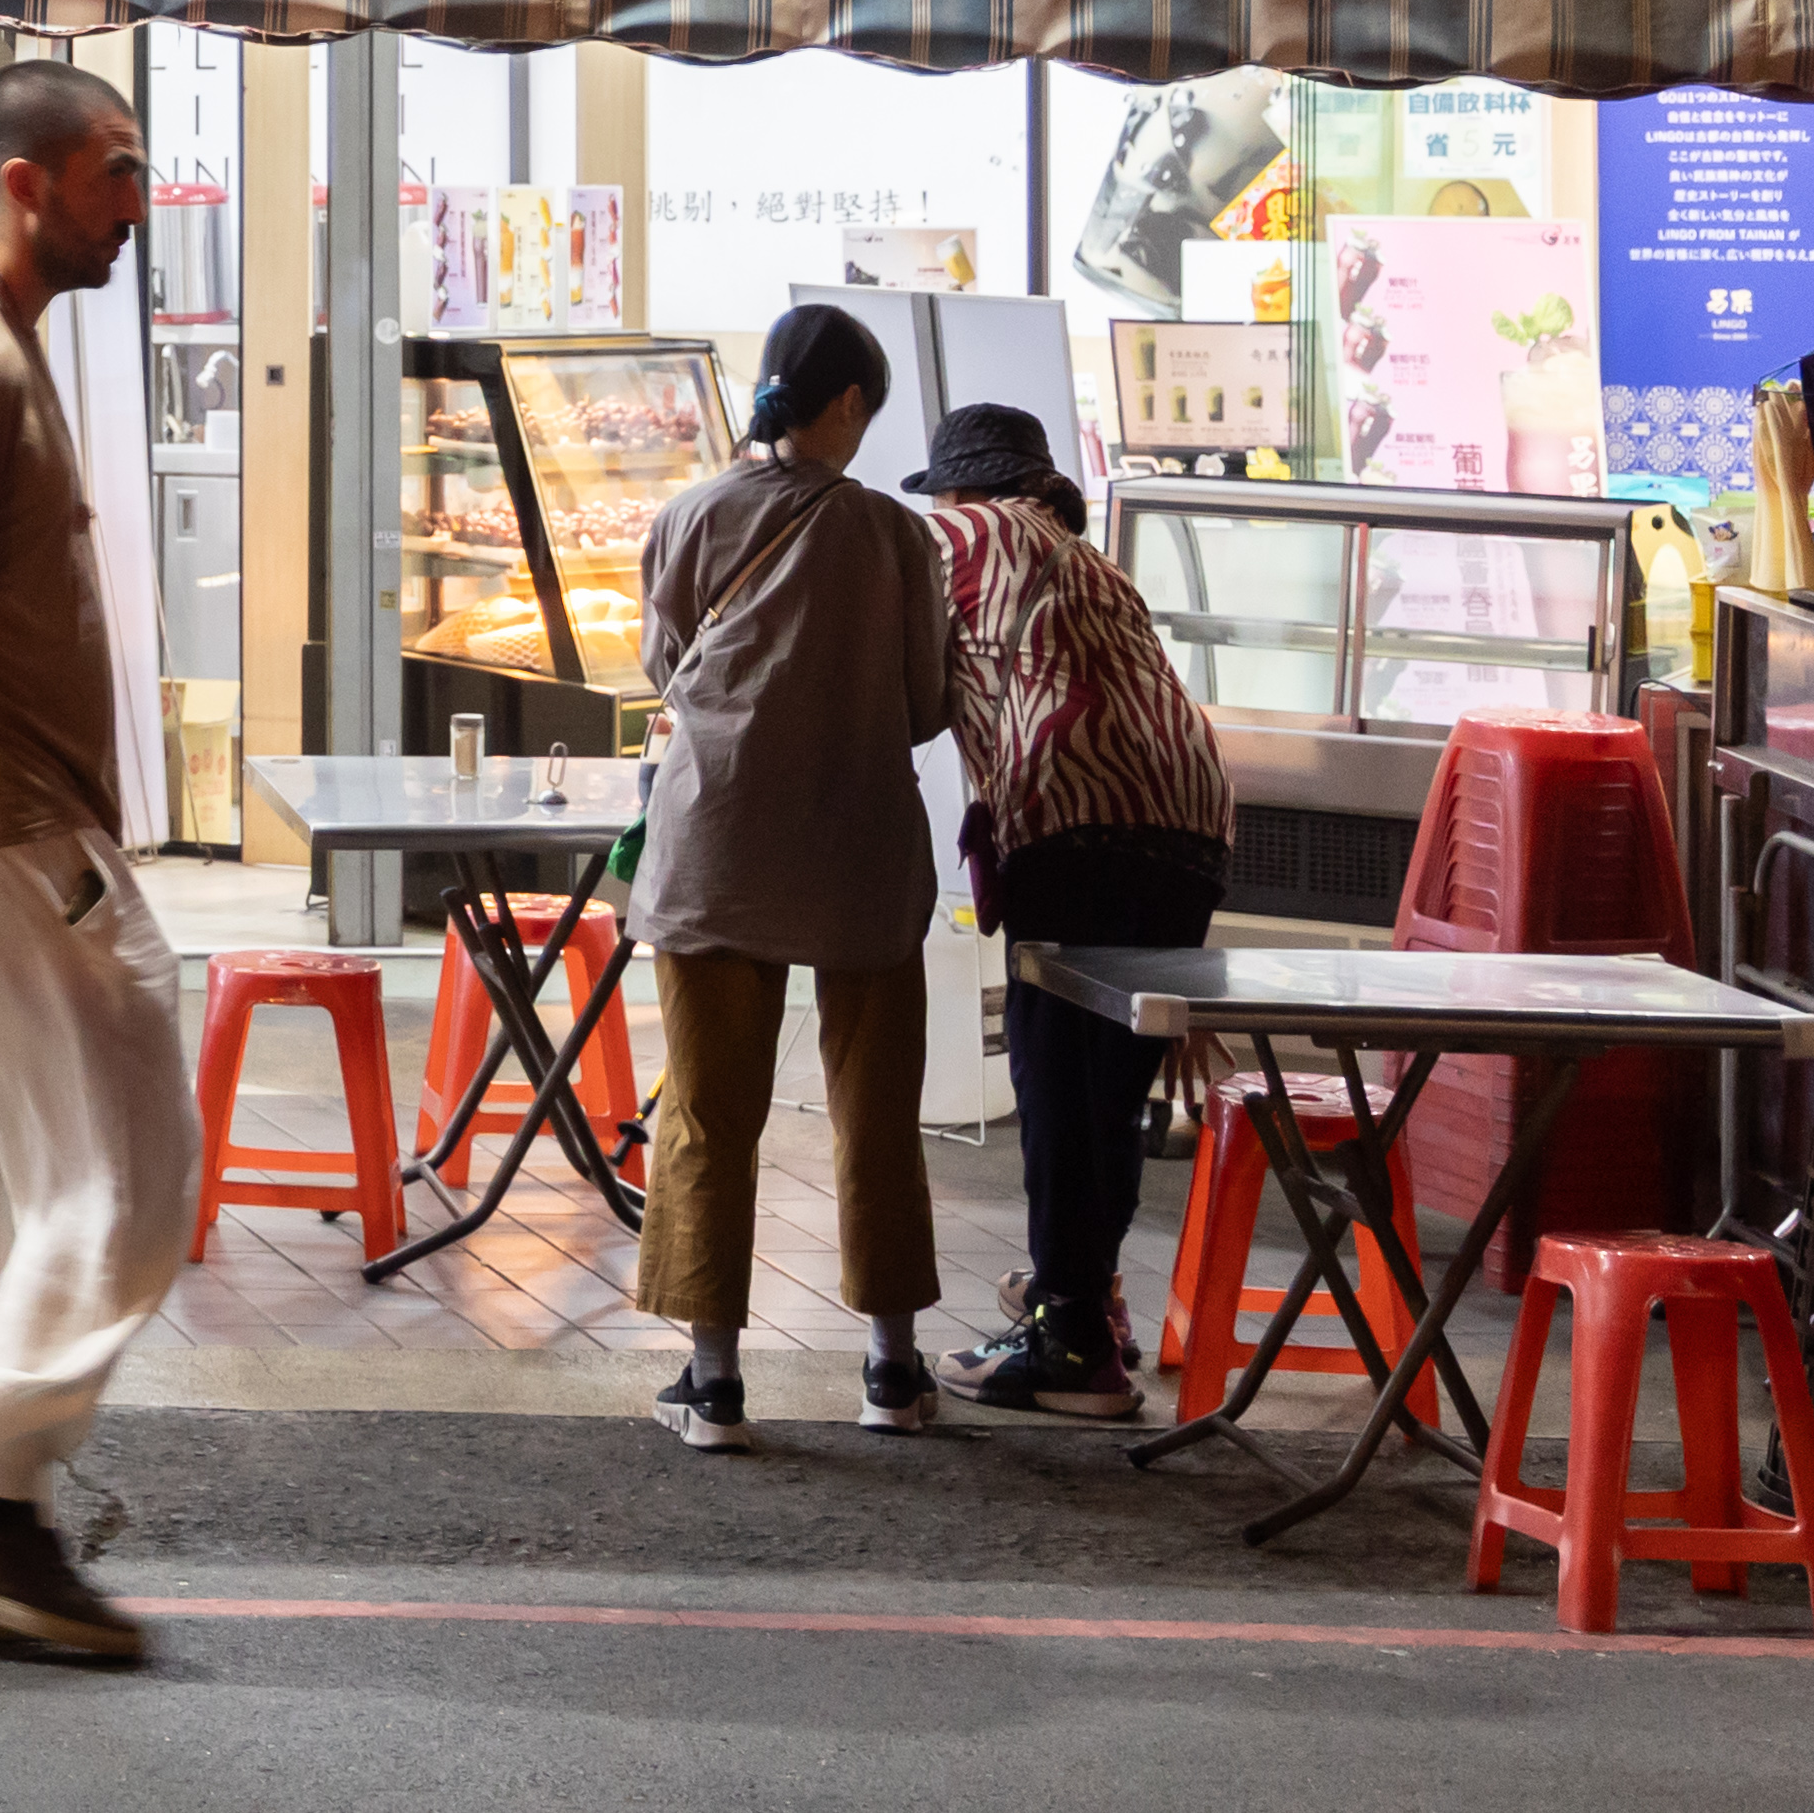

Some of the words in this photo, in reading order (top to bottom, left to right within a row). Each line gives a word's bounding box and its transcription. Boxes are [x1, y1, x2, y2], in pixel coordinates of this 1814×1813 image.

[1408, 92, 1532, 114] 自備飲料杯
